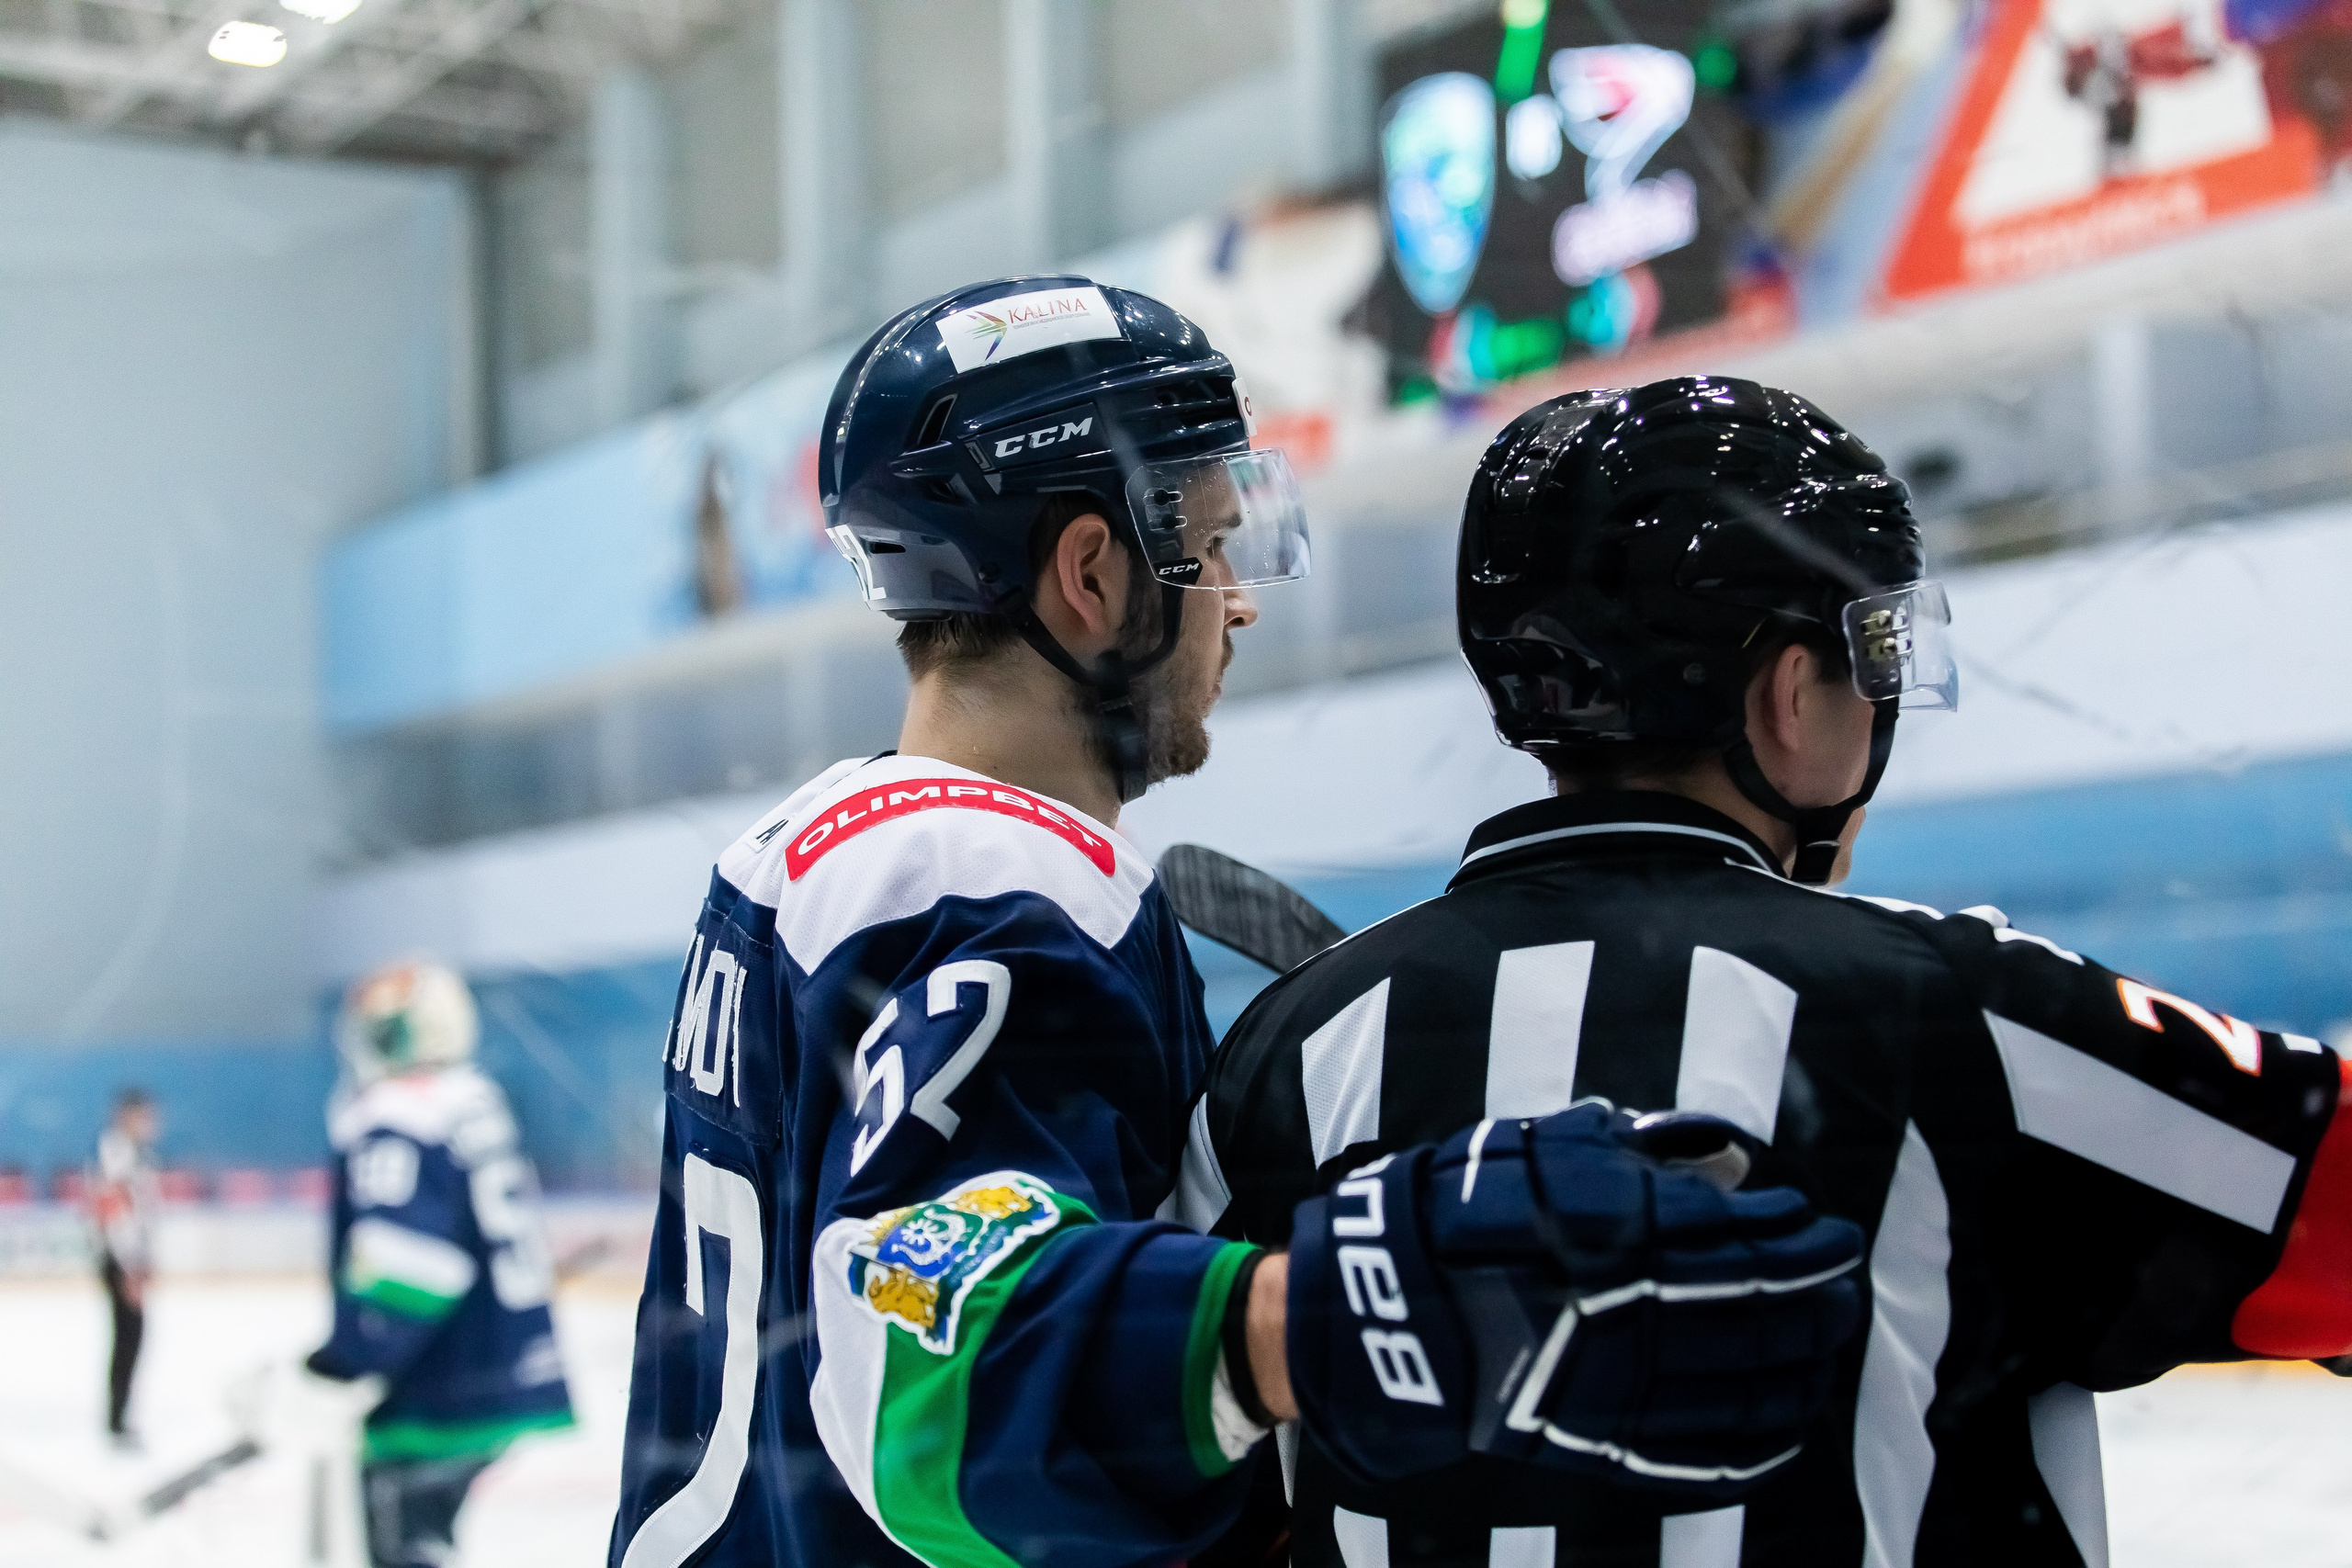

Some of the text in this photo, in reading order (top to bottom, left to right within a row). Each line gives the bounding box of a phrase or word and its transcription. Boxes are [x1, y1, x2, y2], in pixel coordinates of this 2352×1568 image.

[1007, 298, 1088, 324] KALINA
[994, 417, 1093, 458] CCM
[1159, 562, 1200, 575] CCM
[797, 785, 1102, 856] OLIMPBET
[850, 960, 1010, 1178] 52
